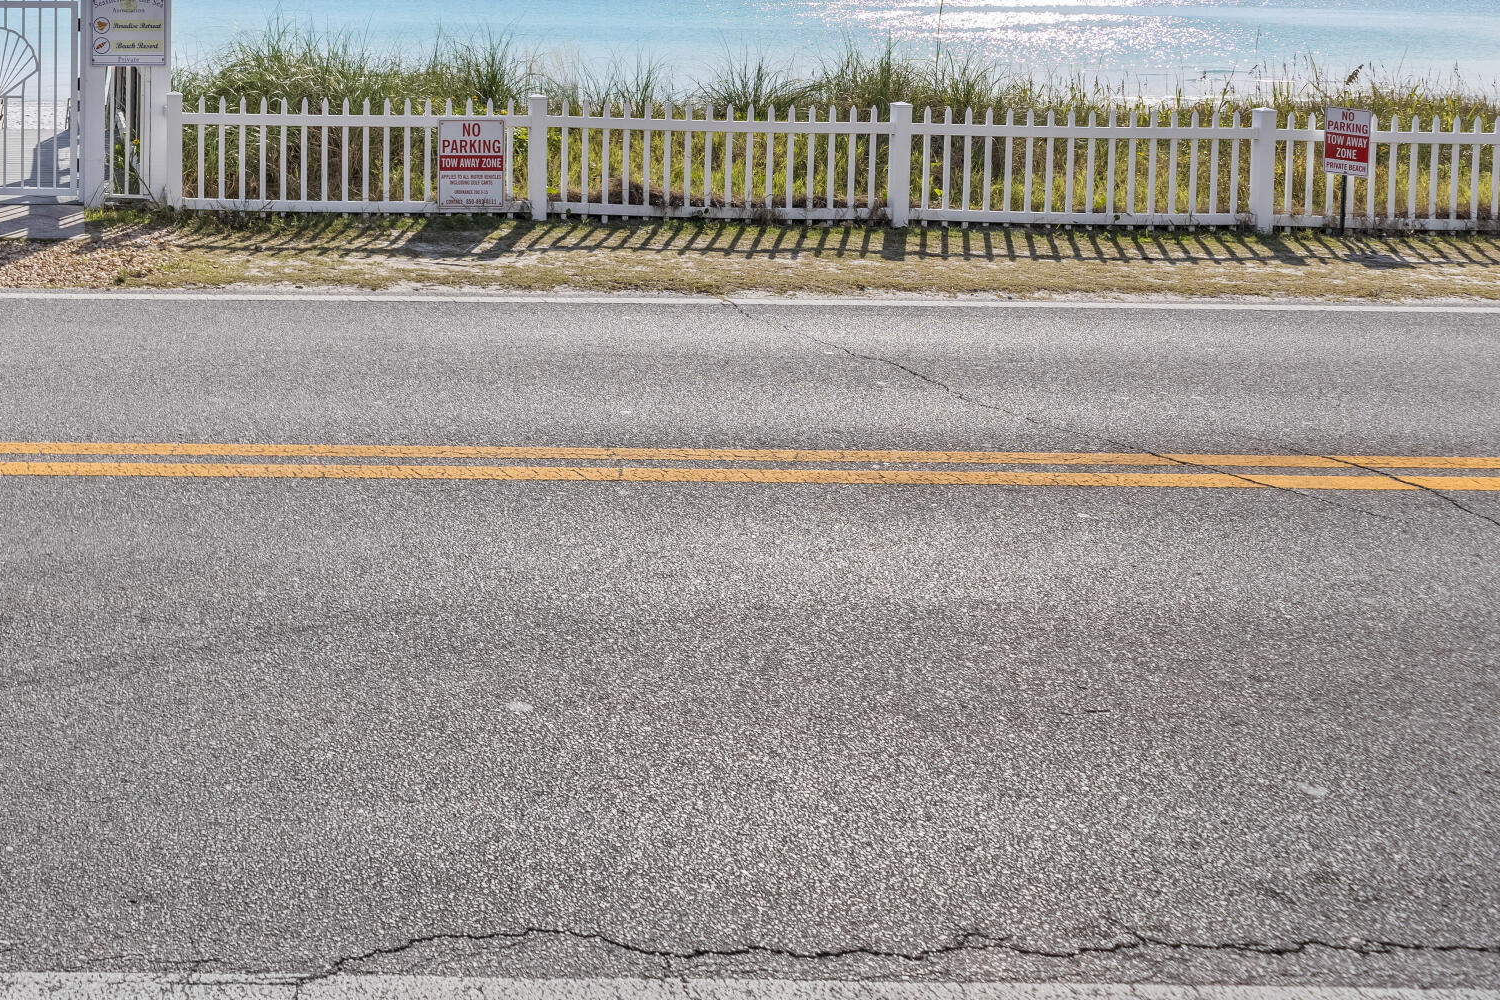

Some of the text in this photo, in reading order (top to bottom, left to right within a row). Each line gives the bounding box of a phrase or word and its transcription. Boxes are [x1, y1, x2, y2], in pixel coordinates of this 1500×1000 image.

[152, 0, 164, 8] Sea
[116, 41, 159, 49] Beach Resort
[1342, 111, 1355, 121] NO
[462, 122, 481, 137] NO
[1327, 120, 1369, 135] PARKING
[442, 139, 501, 153] PARKING
[1326, 134, 1368, 148] TOW AWAY
[1336, 147, 1357, 160] ZONE
[441, 158, 502, 168] TOW AWAY ZONE
[1326, 161, 1366, 173] PRIVATE BEACH
